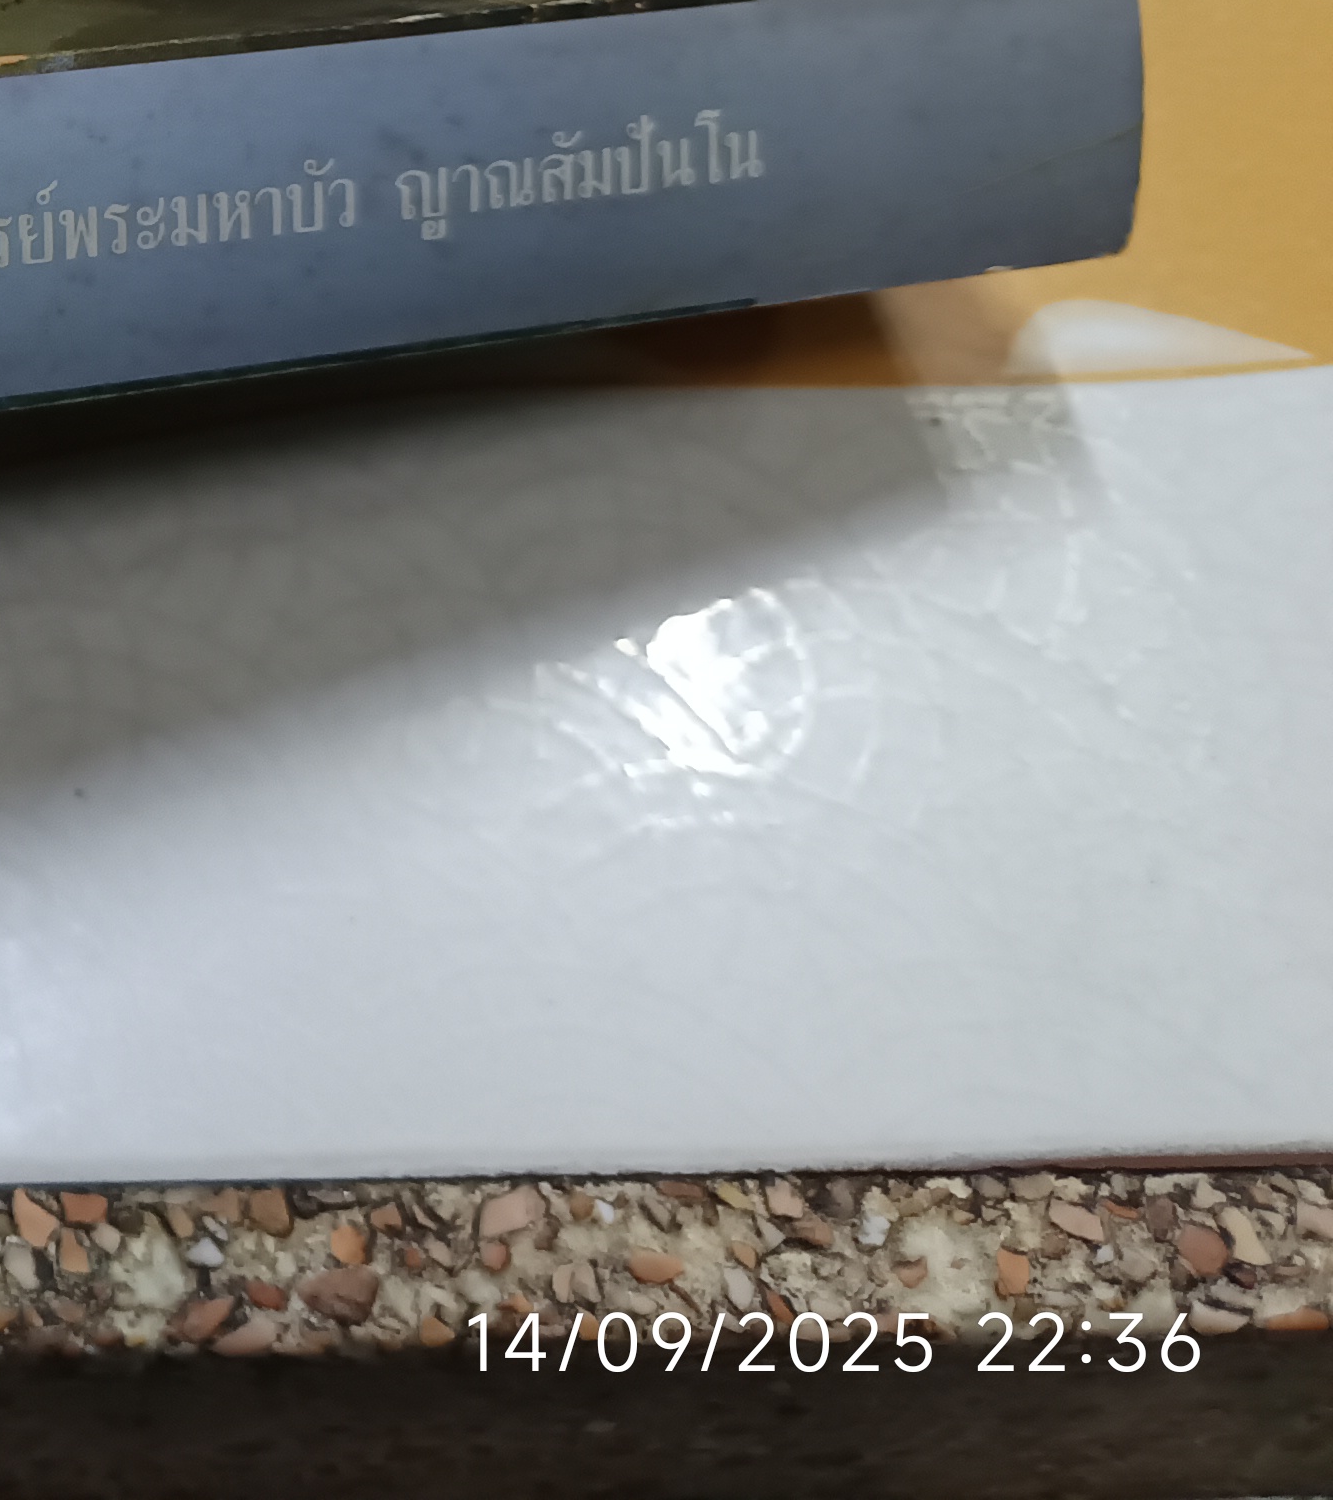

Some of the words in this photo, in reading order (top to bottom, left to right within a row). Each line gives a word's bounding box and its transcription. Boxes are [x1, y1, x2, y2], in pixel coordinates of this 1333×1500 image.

[394, 109, 765, 241] ญาณสัมปันโน
